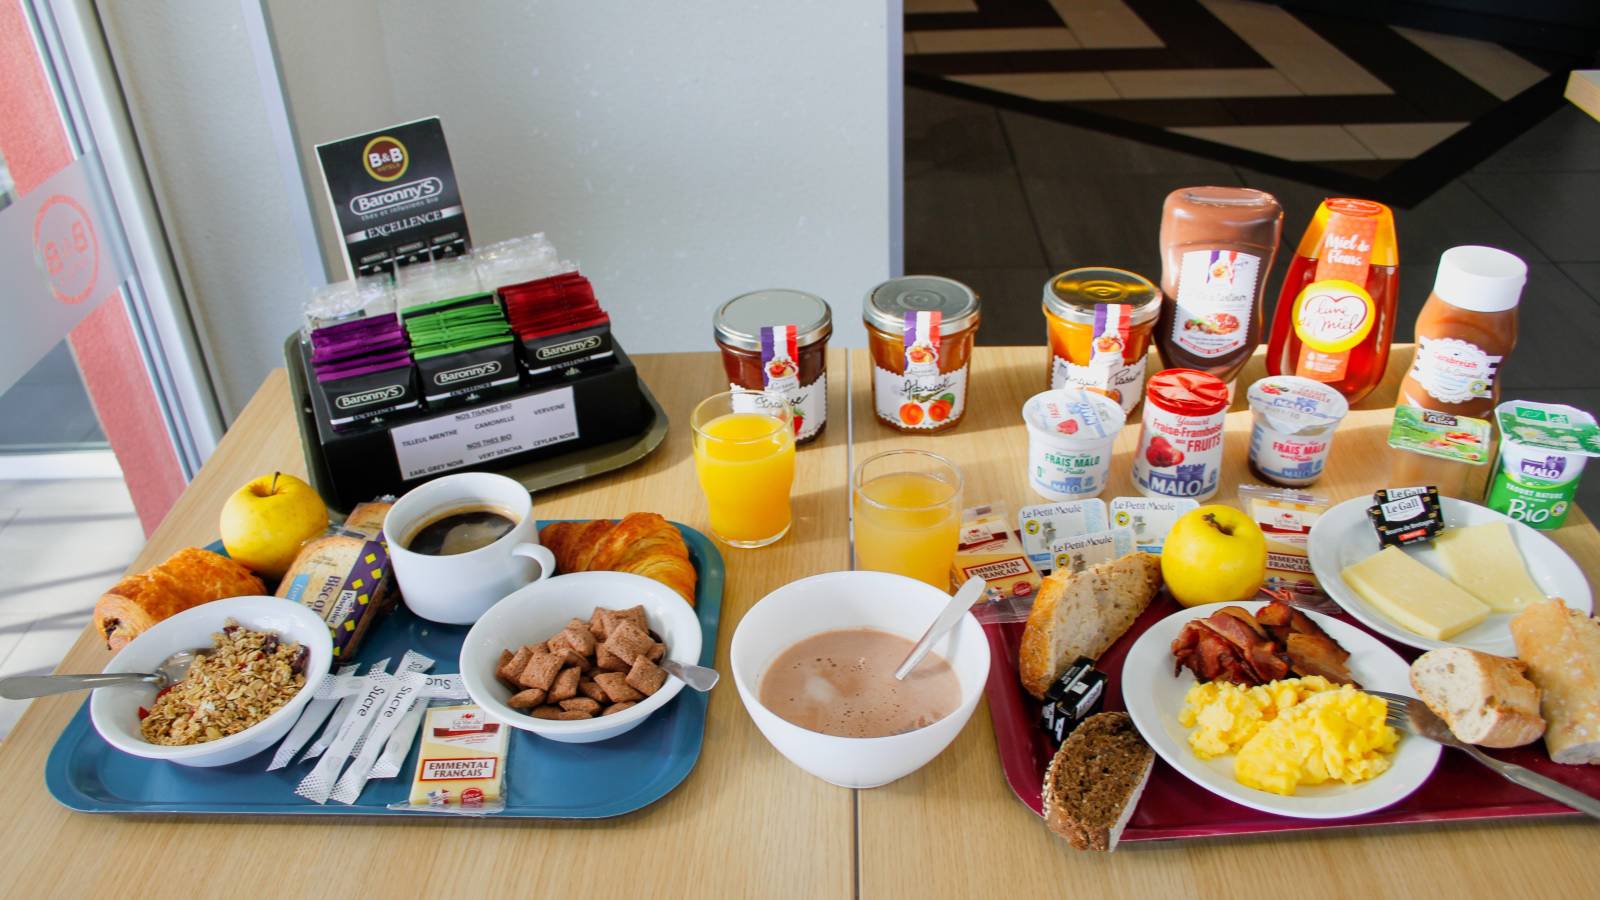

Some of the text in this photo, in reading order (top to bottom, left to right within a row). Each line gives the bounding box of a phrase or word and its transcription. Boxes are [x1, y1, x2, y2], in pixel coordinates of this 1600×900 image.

[369, 147, 404, 168] B&B
[366, 210, 442, 239] EXCELLENCE
[1325, 233, 1358, 250] Miel
[456, 403, 513, 421] NOS TISANES BIO
[533, 403, 565, 415] VERVEINE
[474, 415, 515, 429] CAMOMILLE
[401, 429, 458, 447] TILLEUL MENTHE
[466, 442, 481, 450] NOS
[500, 433, 512, 441] BIO
[532, 431, 576, 446] CEYLAN NOIR
[1186, 433, 1221, 453] FRUITS
[478, 445, 523, 460] VERT SENCHA
[1272, 441, 1299, 455] FRAIS
[1303, 442, 1327, 455] MALO
[1045, 452, 1072, 467] FRAIS
[1074, 455, 1100, 467] MALO
[409, 459, 464, 477] EARL GREY NOIR
[1523, 464, 1560, 479] MALO
[1151, 477, 1201, 496] MALO
[1391, 490, 1402, 498] Le
[1022, 510, 1032, 519] Le
[1033, 506, 1054, 518] Petit
[1114, 501, 1124, 510] Le
[1126, 500, 1147, 511] Petit
[1385, 498, 1420, 514] Le Gall
[1507, 498, 1550, 523] Bio
[1053, 543, 1063, 553] Le
[1064, 540, 1085, 552] Petit
[969, 560, 1021, 576] EMMENTAL
[359, 685, 385, 717] Sucre
[383, 685, 412, 718] Sucre
[429, 761, 489, 770] EMMENTAL
